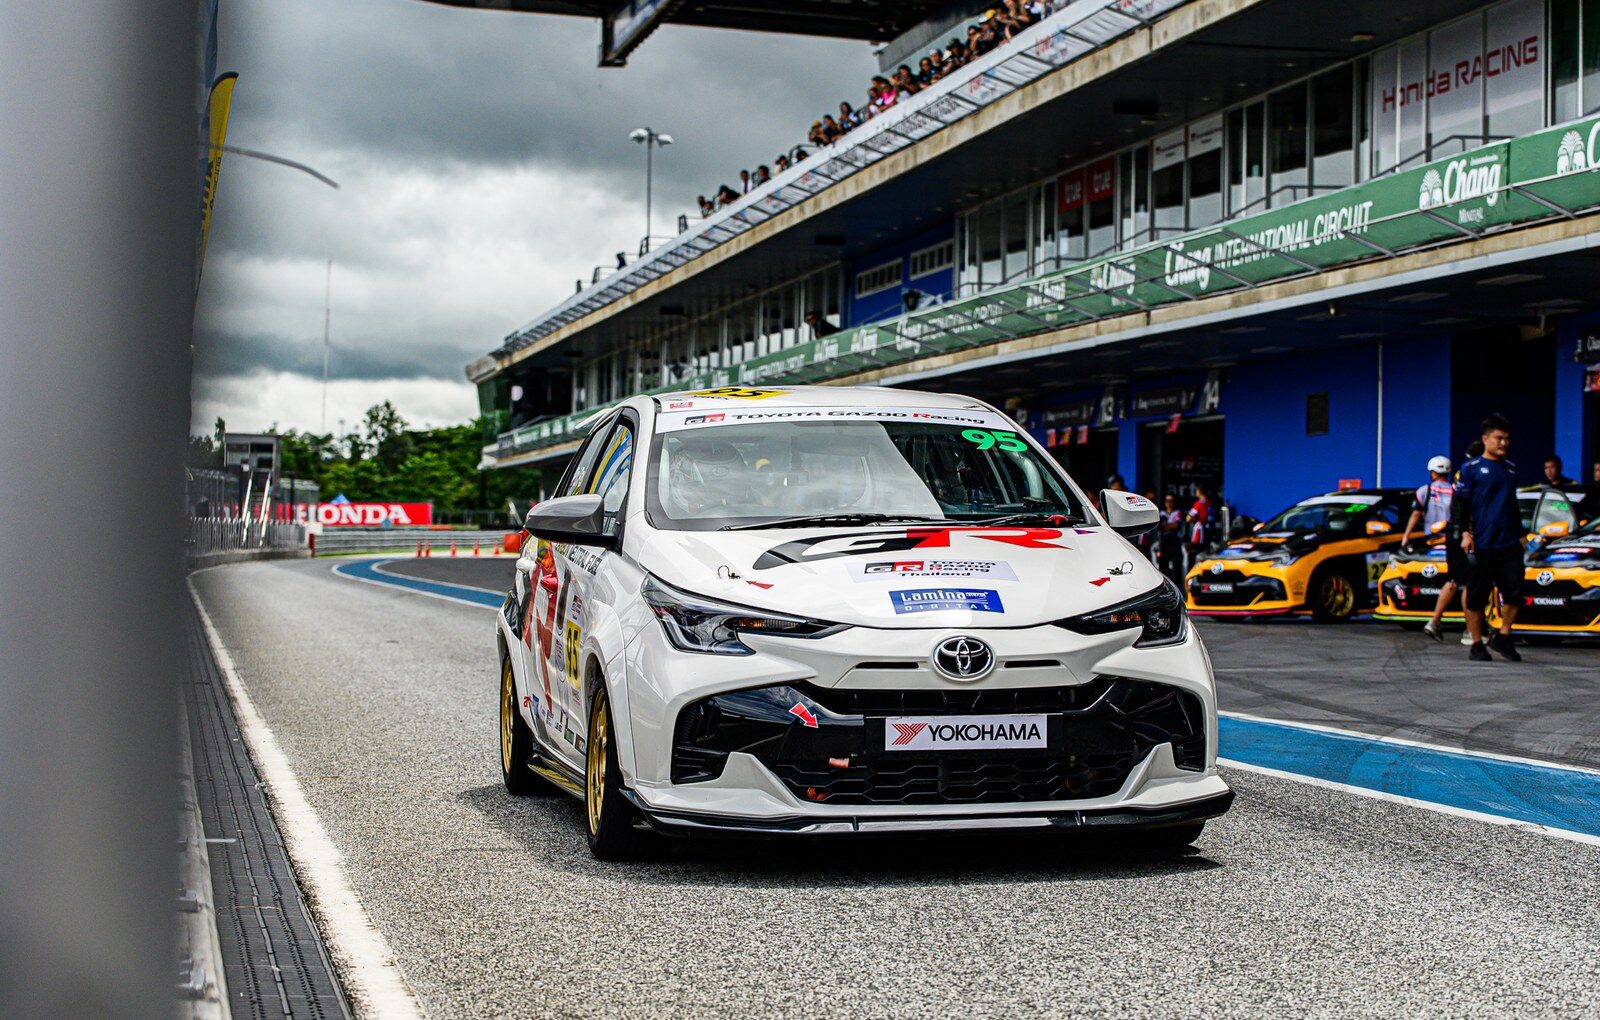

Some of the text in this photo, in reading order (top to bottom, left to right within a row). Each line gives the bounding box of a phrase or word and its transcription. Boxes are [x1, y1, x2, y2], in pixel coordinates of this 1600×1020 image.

[1382, 35, 1538, 113] Honda RACING
[1443, 158, 1500, 207] Chang
[1213, 218, 1311, 271] INTERNATIONAL
[1313, 201, 1373, 246] CIRCUIT
[685, 410, 986, 426] GR TOYOTA GAZOO Racing
[961, 429, 1028, 453] 95
[297, 503, 412, 525] HONDA
[752, 527, 1074, 571] GR
[864, 560, 925, 575] GR
[900, 588, 967, 602] Lamina
[904, 602, 992, 612] DIGITAL
[566, 627, 579, 681] 95
[927, 723, 1042, 743] YOKOHAMA
